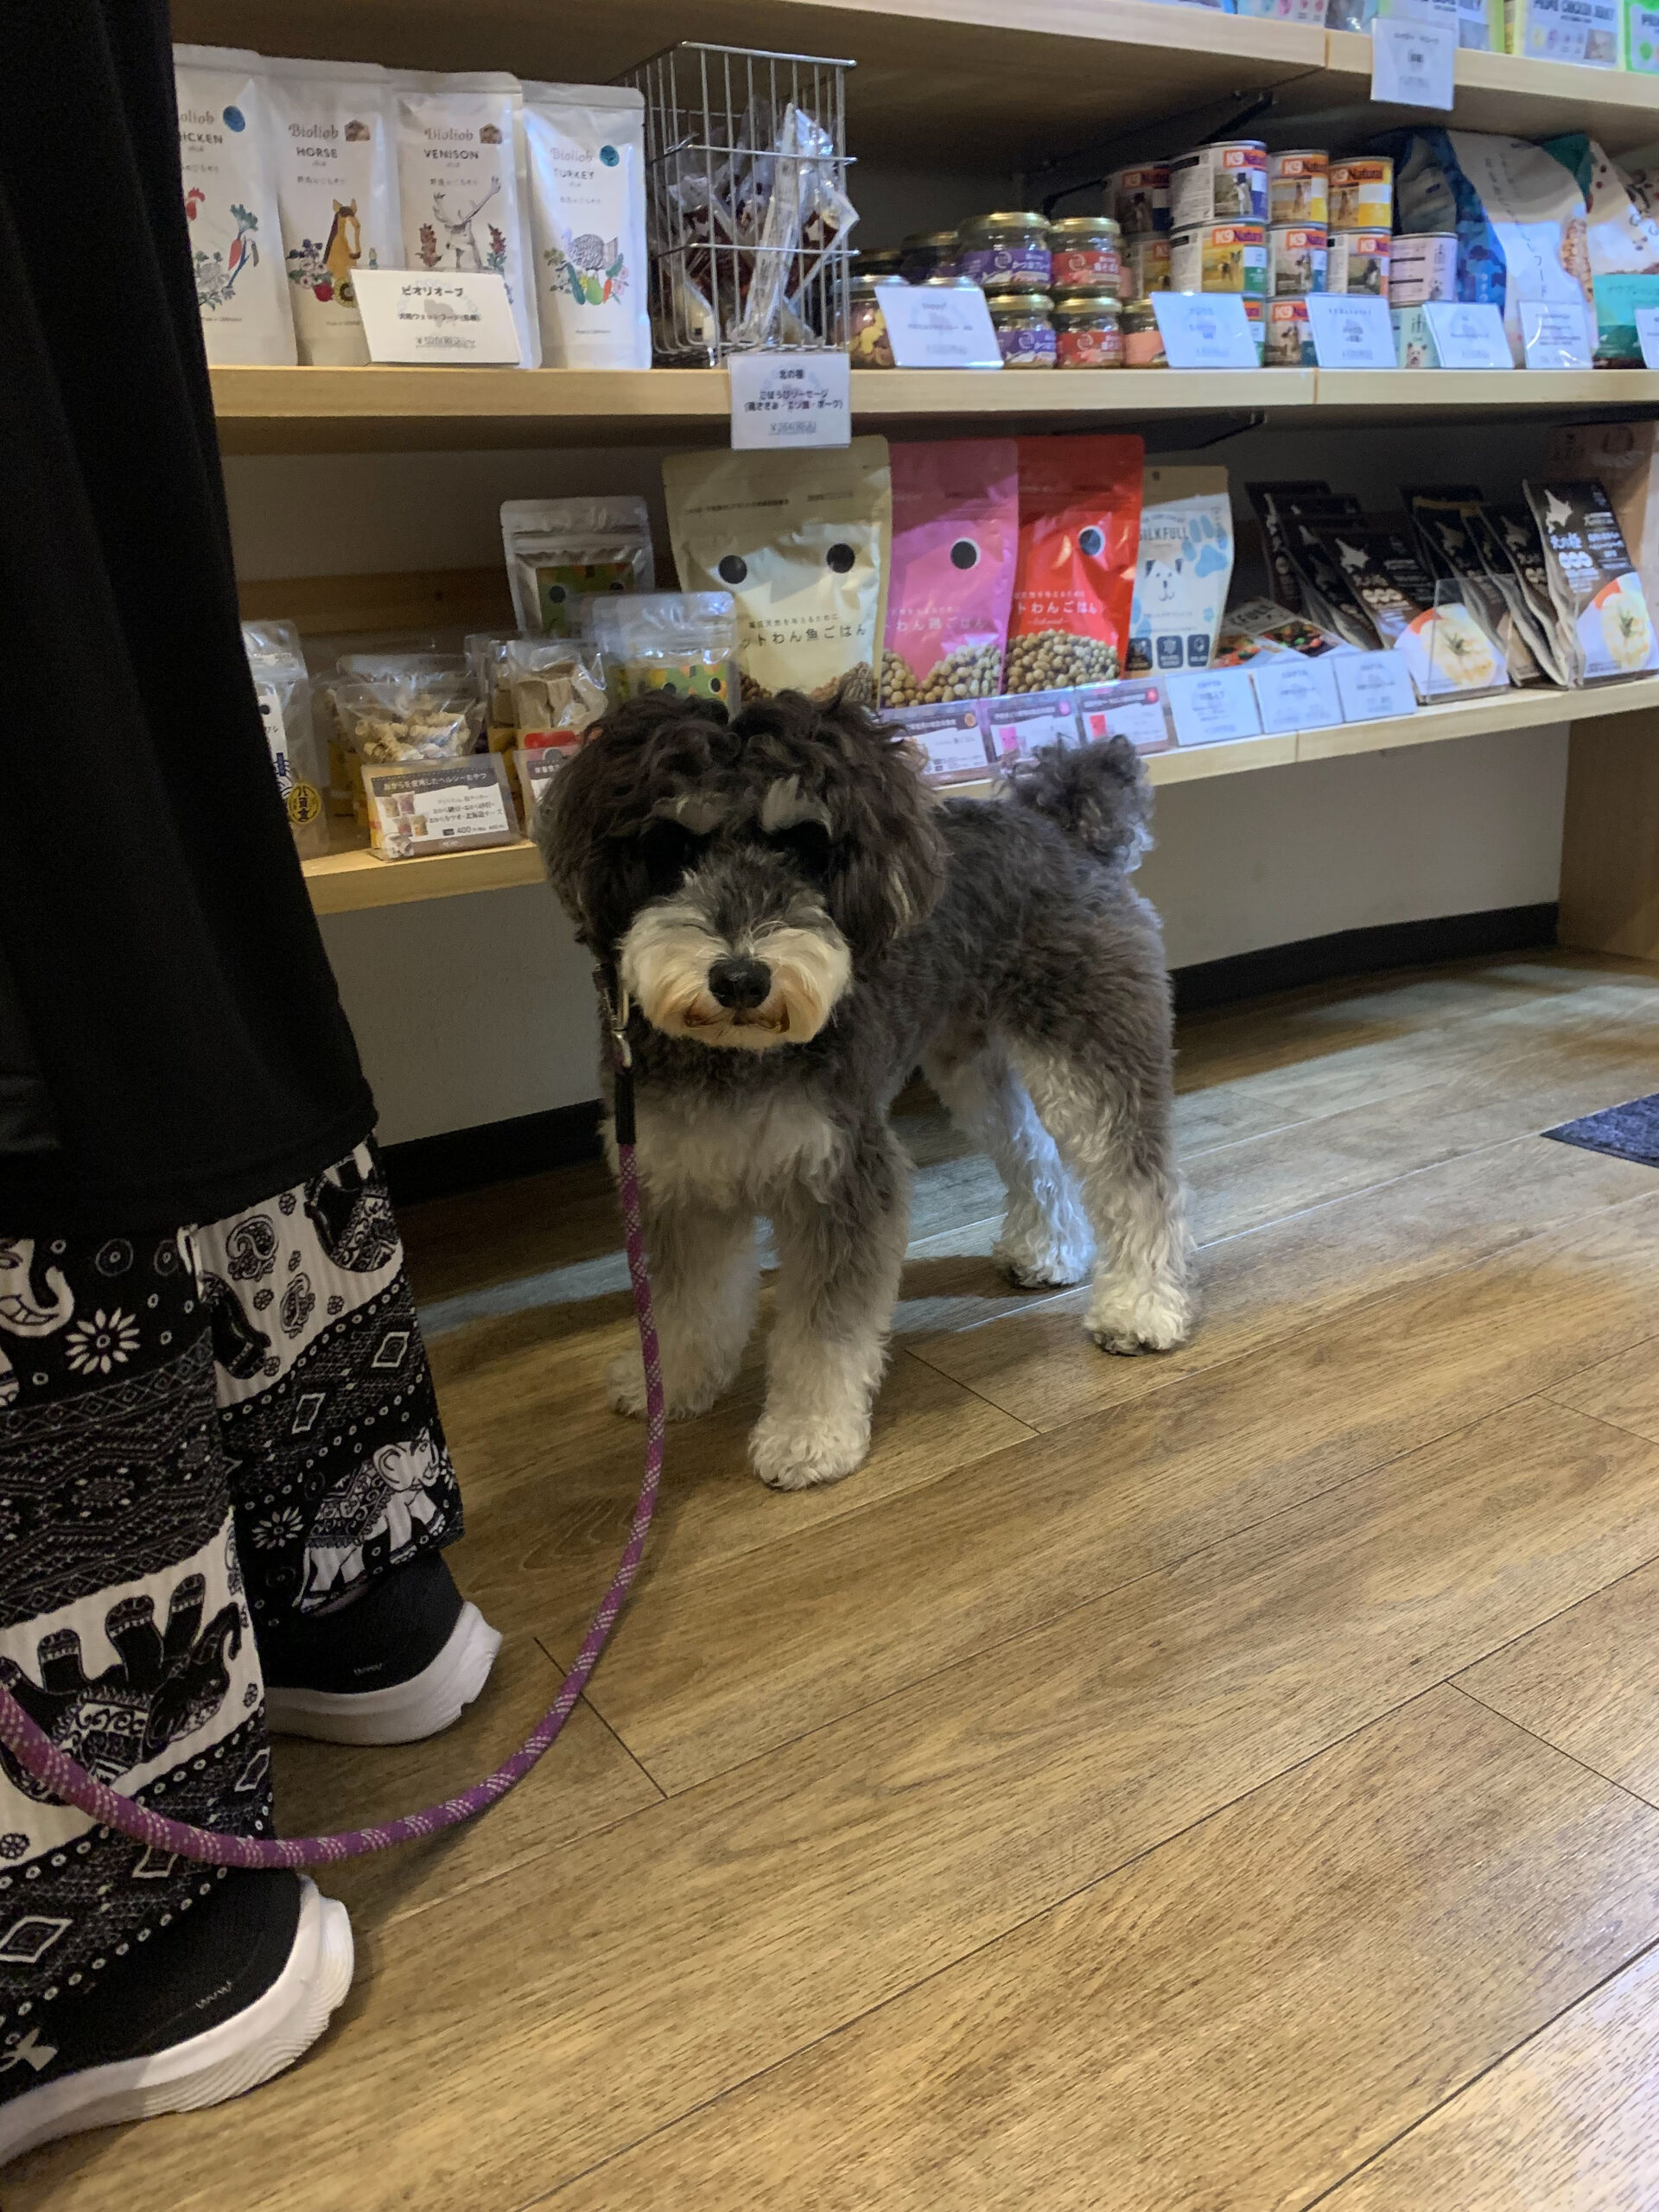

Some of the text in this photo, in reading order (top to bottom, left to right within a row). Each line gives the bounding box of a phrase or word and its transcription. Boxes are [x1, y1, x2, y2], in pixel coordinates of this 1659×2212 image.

[179, 130, 223, 145] ICKEN
[296, 146, 339, 159] HORSE
[423, 148, 480, 160] VENISON
[740, 623, 866, 650] ットわん魚ごはん
